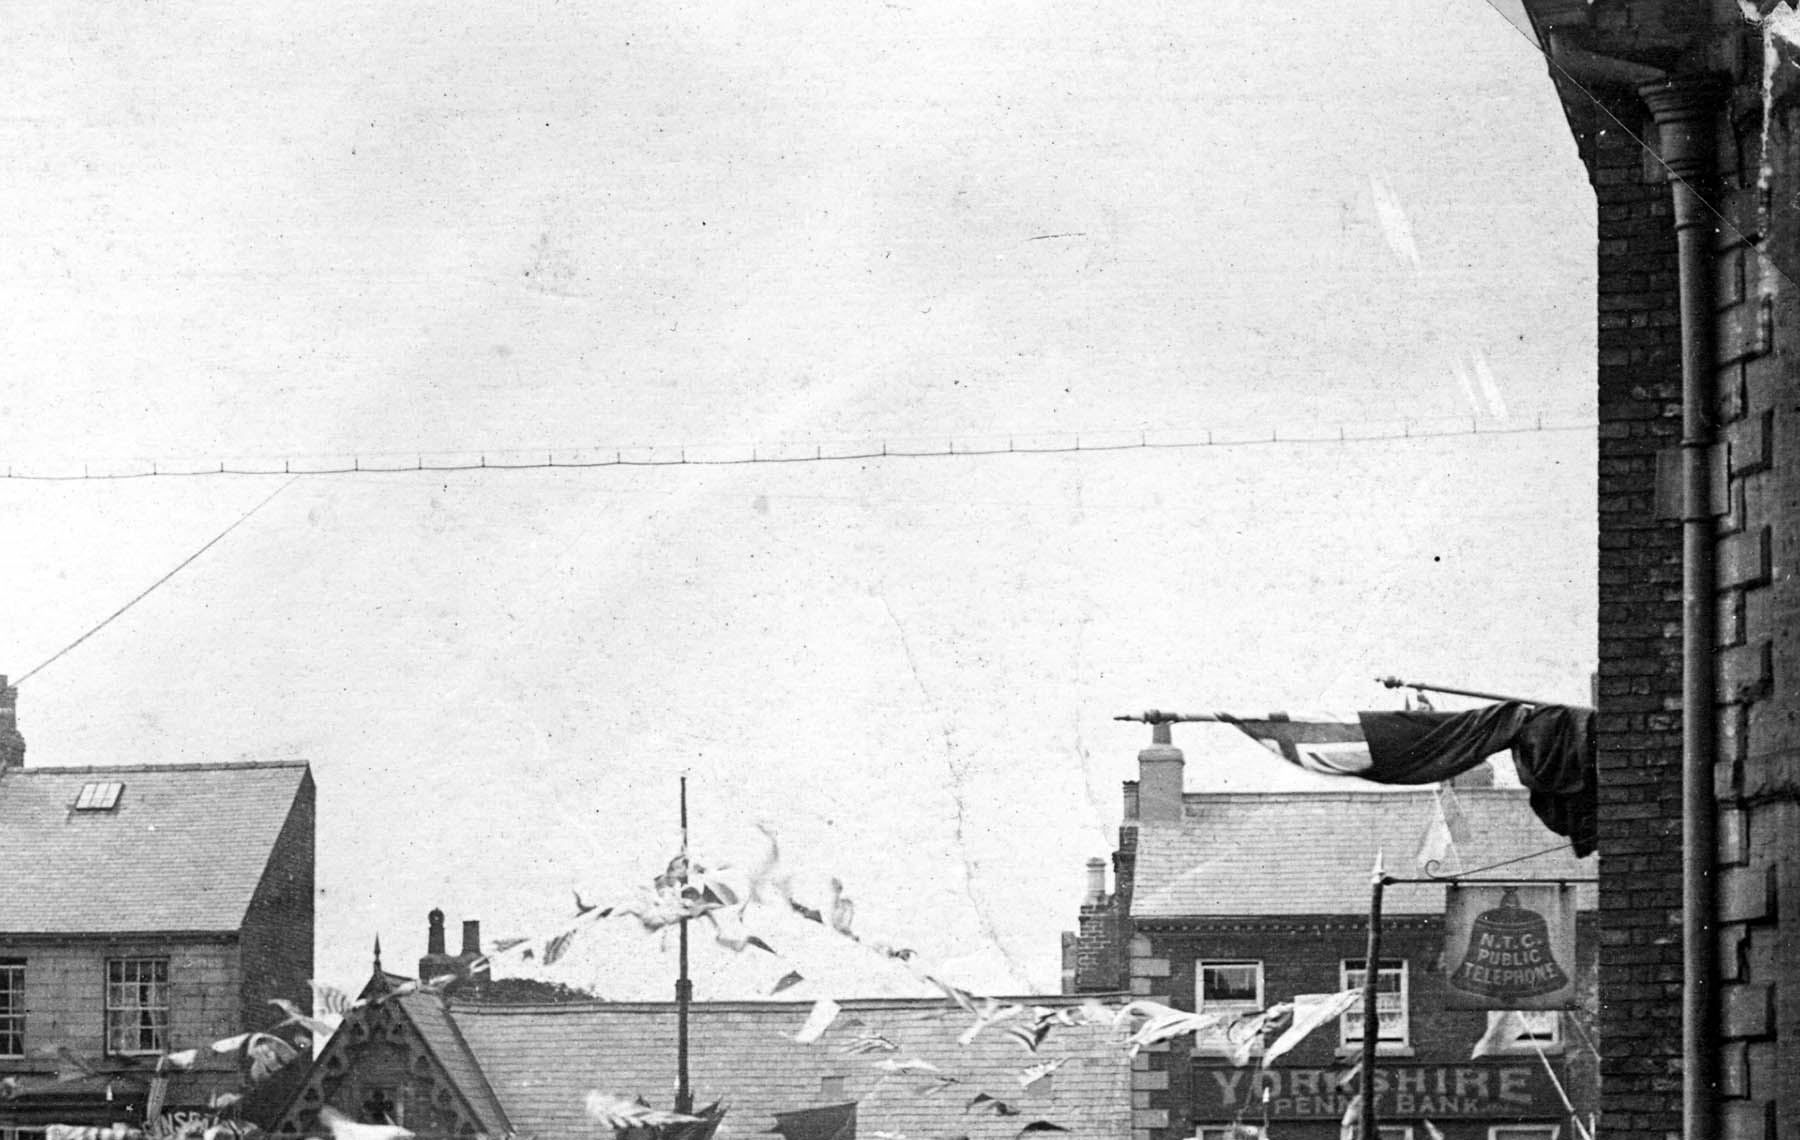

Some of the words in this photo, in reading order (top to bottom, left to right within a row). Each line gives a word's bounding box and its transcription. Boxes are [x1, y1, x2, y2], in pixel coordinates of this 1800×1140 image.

[1477, 948, 1542, 966] PUBLIC
[1463, 961, 1558, 986] TELEPHONE
[1212, 1068, 1533, 1105] YORKSHIRE
[1274, 1098, 1381, 1114] PENN
[1399, 1095, 1479, 1113] BANK
